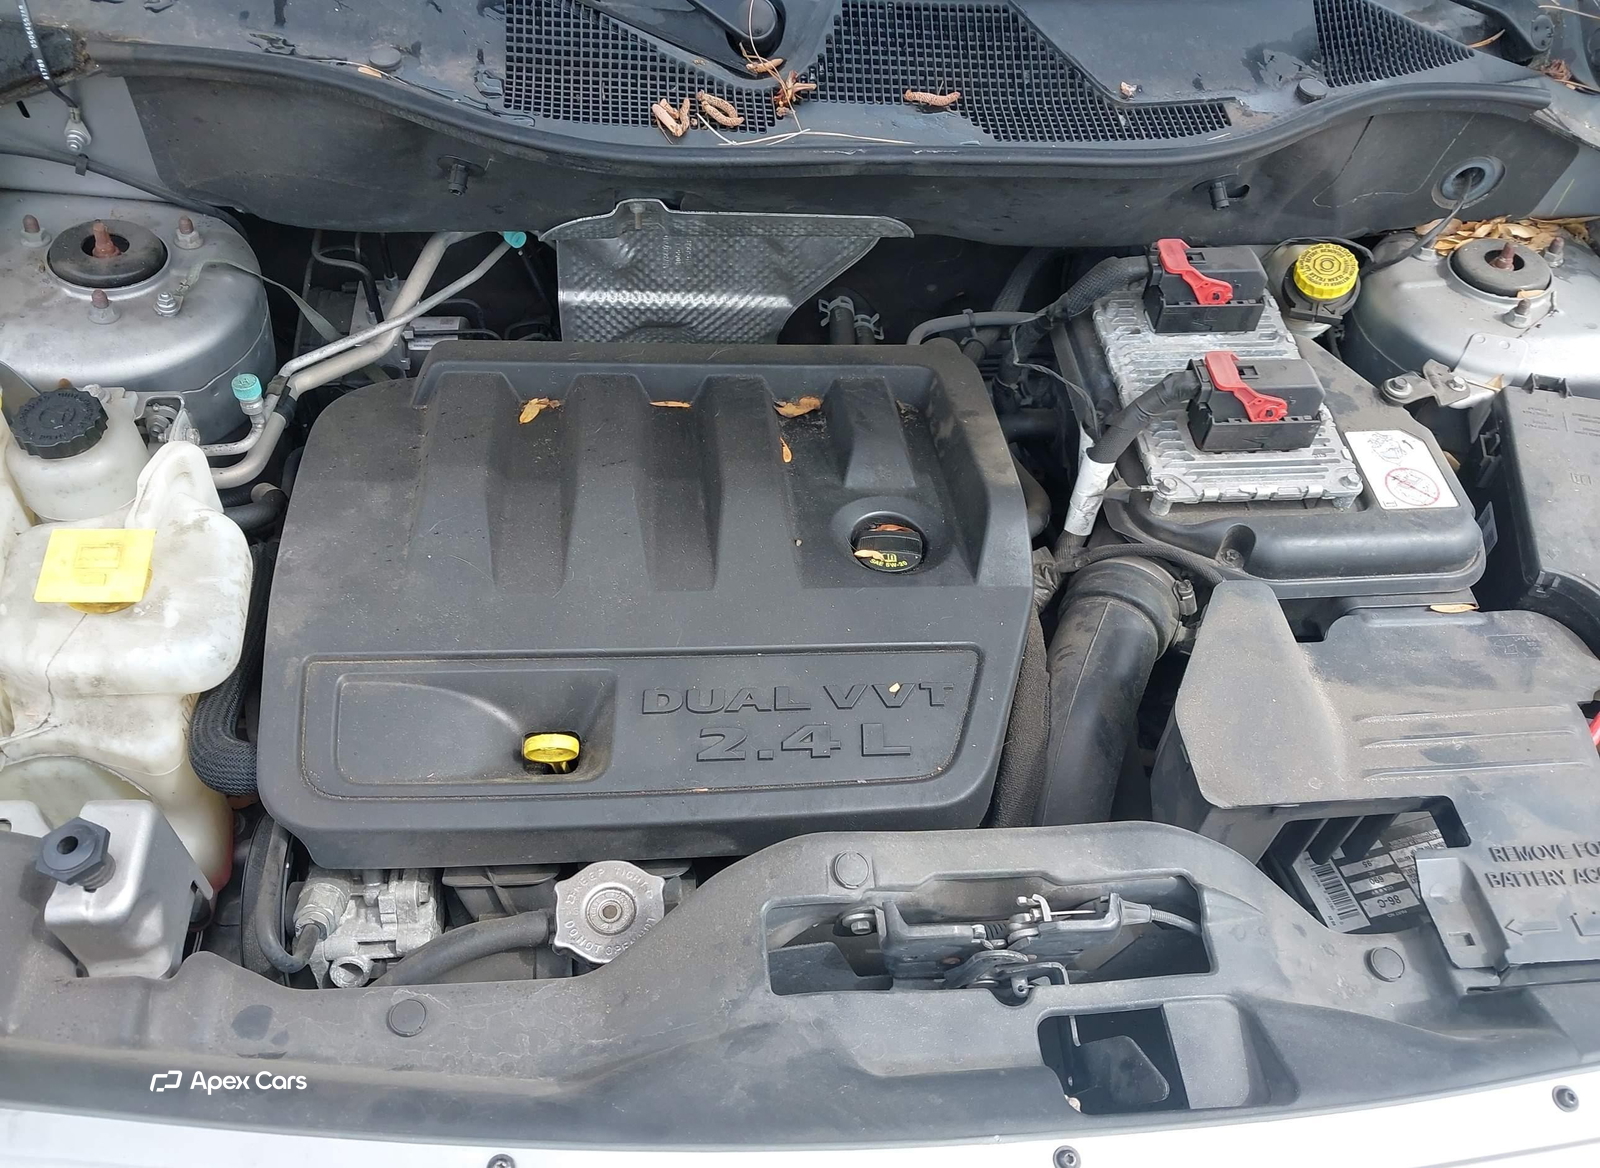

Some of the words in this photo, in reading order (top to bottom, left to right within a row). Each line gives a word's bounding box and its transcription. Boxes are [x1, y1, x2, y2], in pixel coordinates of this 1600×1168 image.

[641, 685, 812, 715] DUAL
[822, 681, 955, 710] VVT
[696, 723, 842, 763] 2.4
[1488, 843, 1573, 863] REMOVE
[1572, 840, 1600, 859] FO
[1484, 869, 1567, 889] BATTERY
[1376, 894, 1402, 909] 86-C
[565, 920, 579, 938] DO
[577, 934, 603, 955] NOT
[605, 939, 637, 956] OPE
